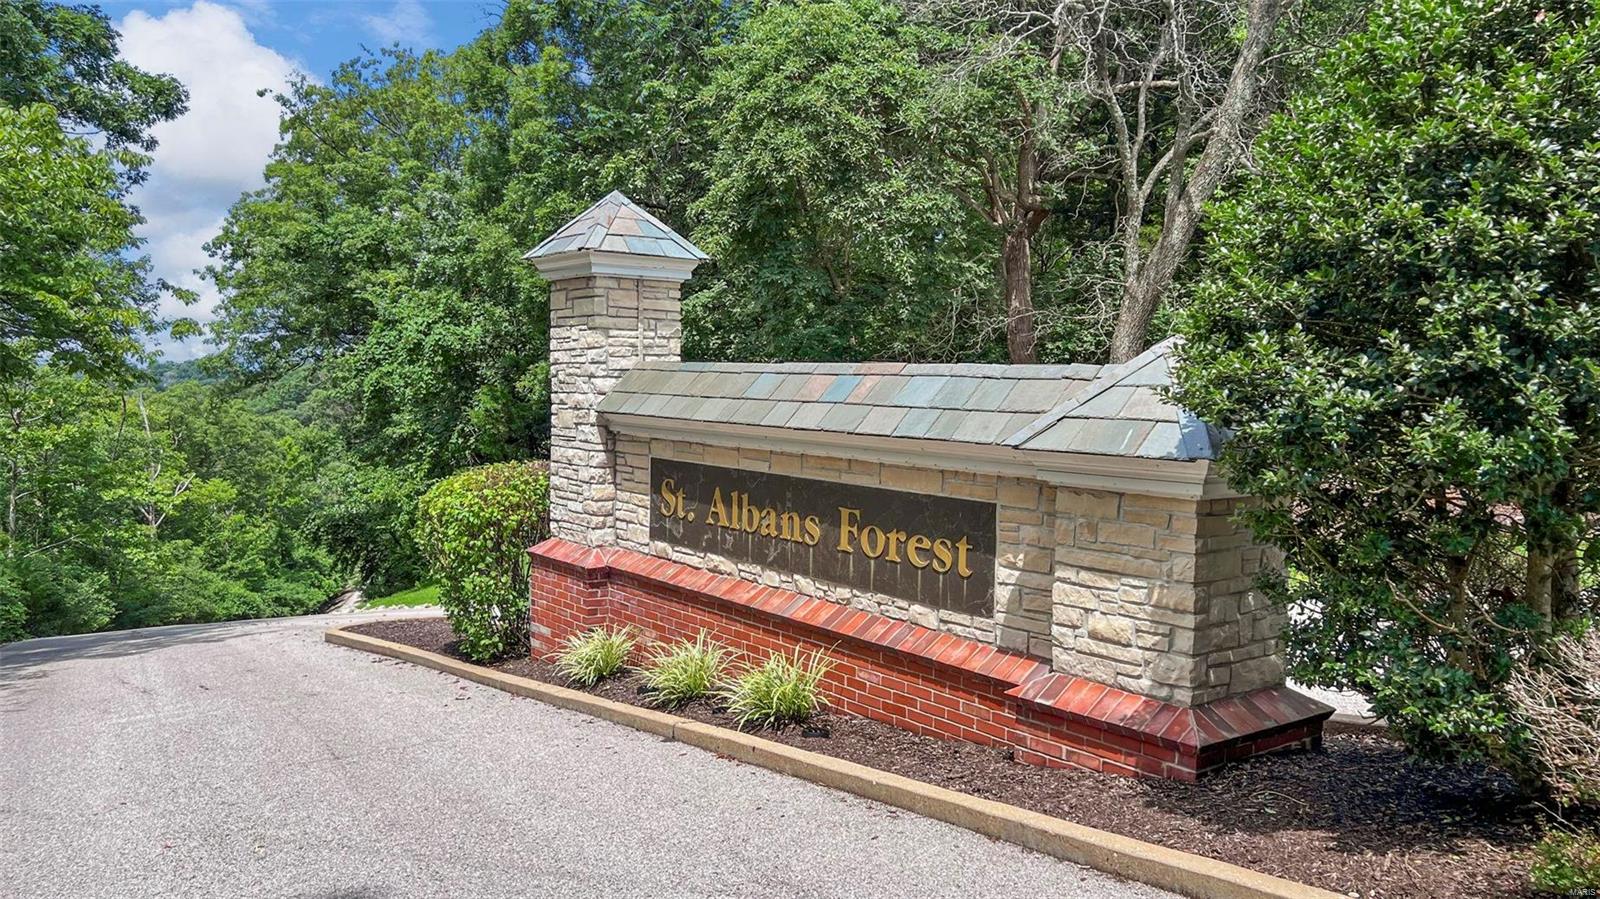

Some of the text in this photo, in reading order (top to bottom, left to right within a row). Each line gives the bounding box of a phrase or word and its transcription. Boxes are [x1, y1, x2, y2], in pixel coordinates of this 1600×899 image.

[660, 478, 974, 578] St. Albans Forest
